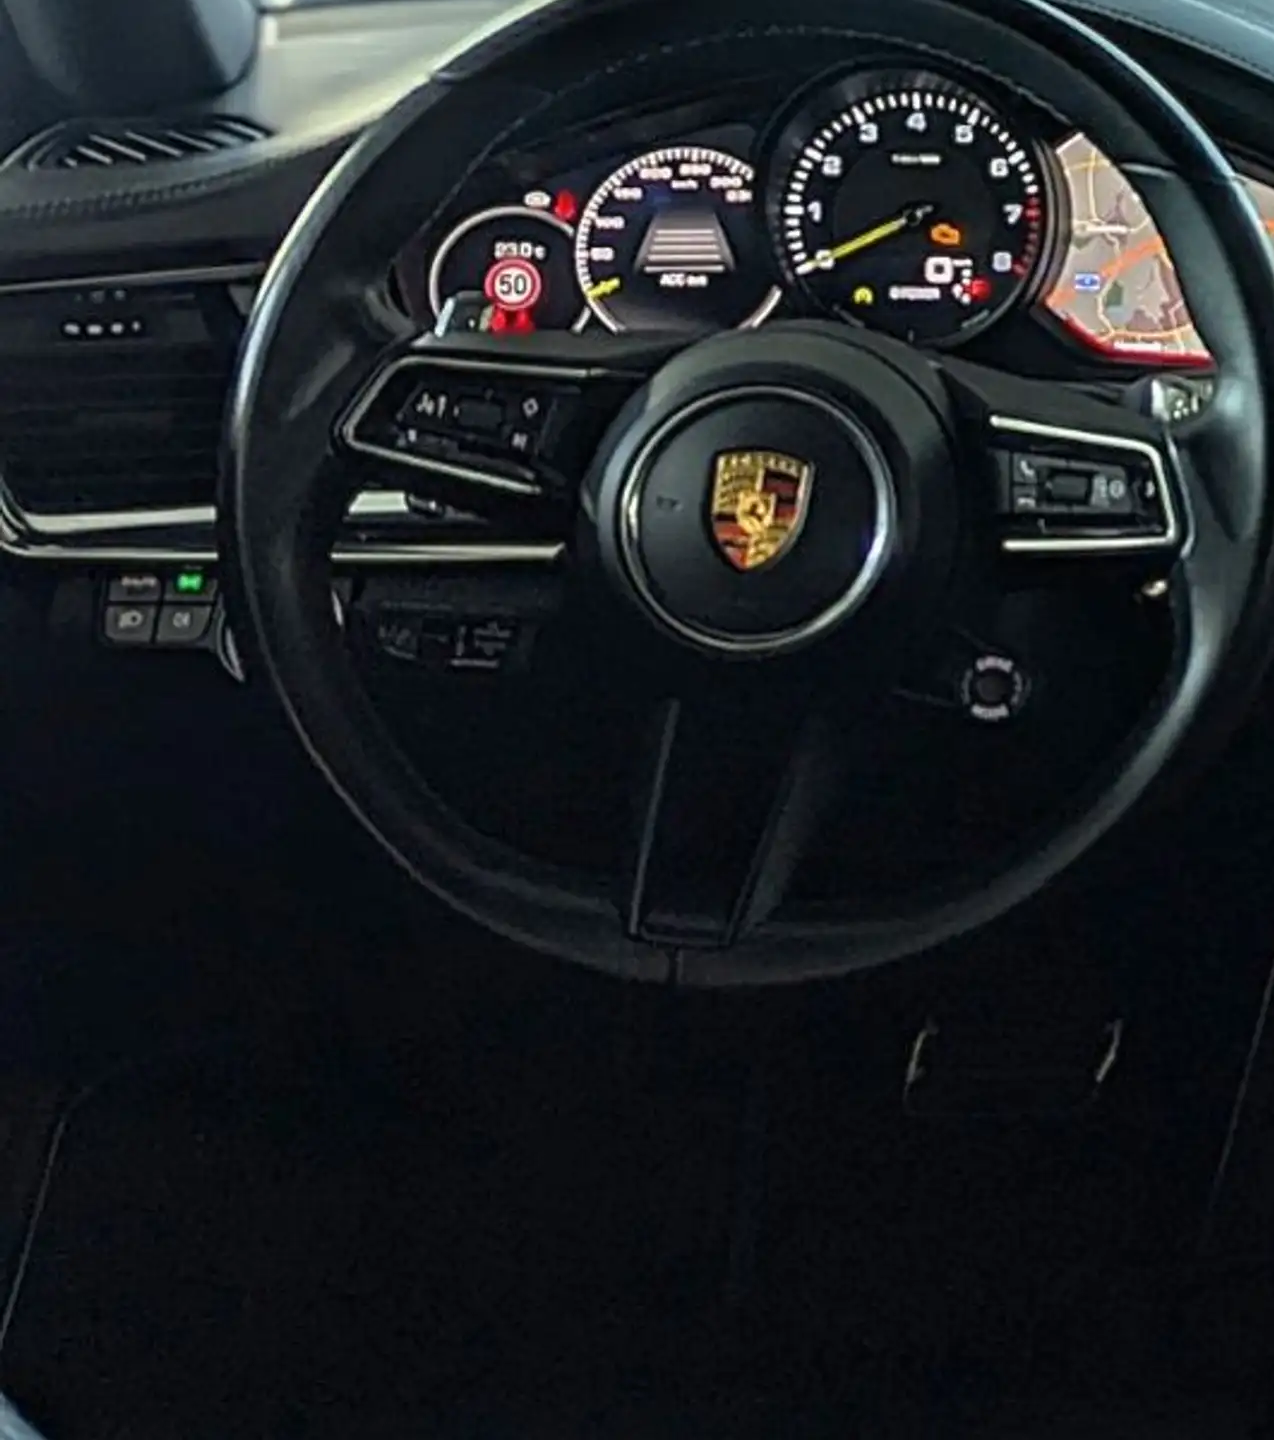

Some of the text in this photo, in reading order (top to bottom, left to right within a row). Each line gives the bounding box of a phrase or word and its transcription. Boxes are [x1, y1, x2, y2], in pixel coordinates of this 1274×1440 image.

[906, 112, 927, 132] 4
[859, 123, 879, 143] 3
[954, 124, 974, 144] 5
[822, 155, 842, 176] 2
[989, 158, 1009, 178] 6
[807, 201, 822, 222] 1
[1003, 203, 1023, 224] 7
[992, 251, 1012, 272] 8
[499, 273, 528, 296] 50
